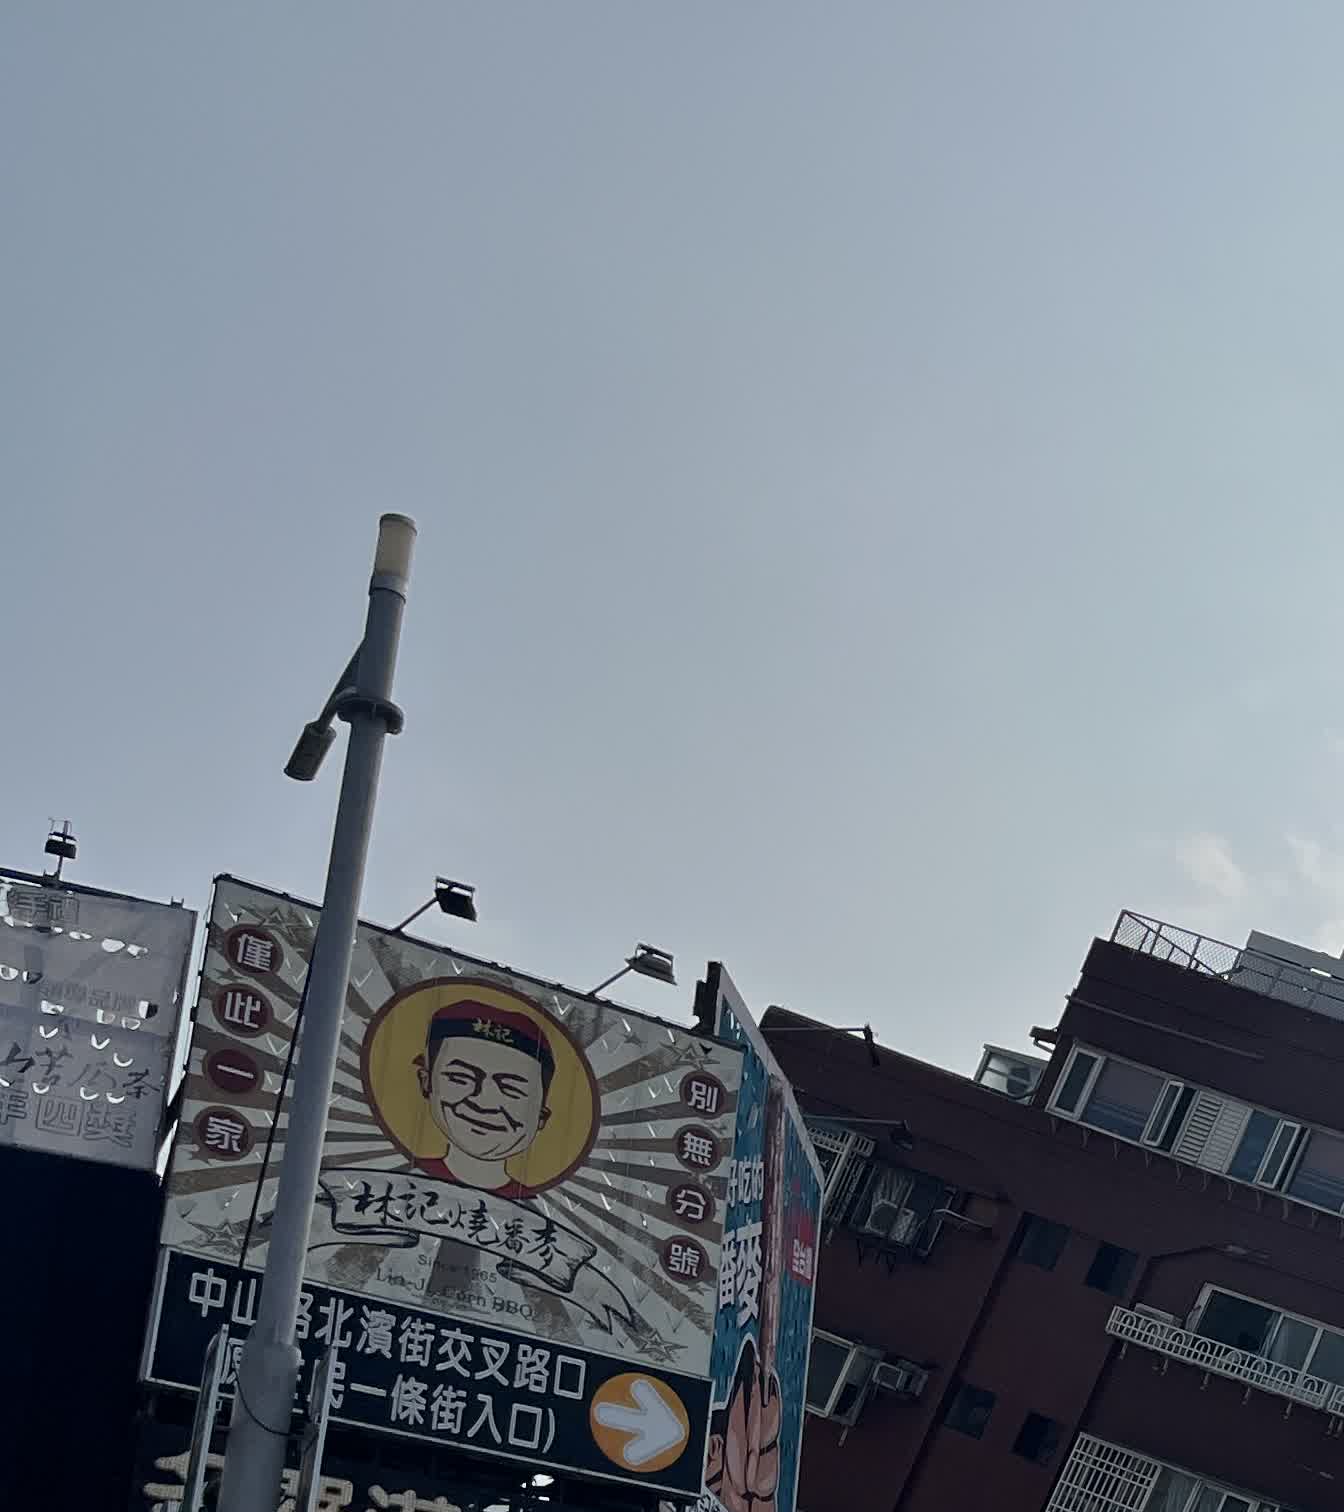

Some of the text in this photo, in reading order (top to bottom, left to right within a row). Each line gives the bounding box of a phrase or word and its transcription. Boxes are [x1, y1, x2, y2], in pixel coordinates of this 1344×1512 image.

[205, 934, 274, 1153] 僅此一家
[671, 1081, 719, 1281] 別無分號
[492, 1296, 534, 1320] BBQ
